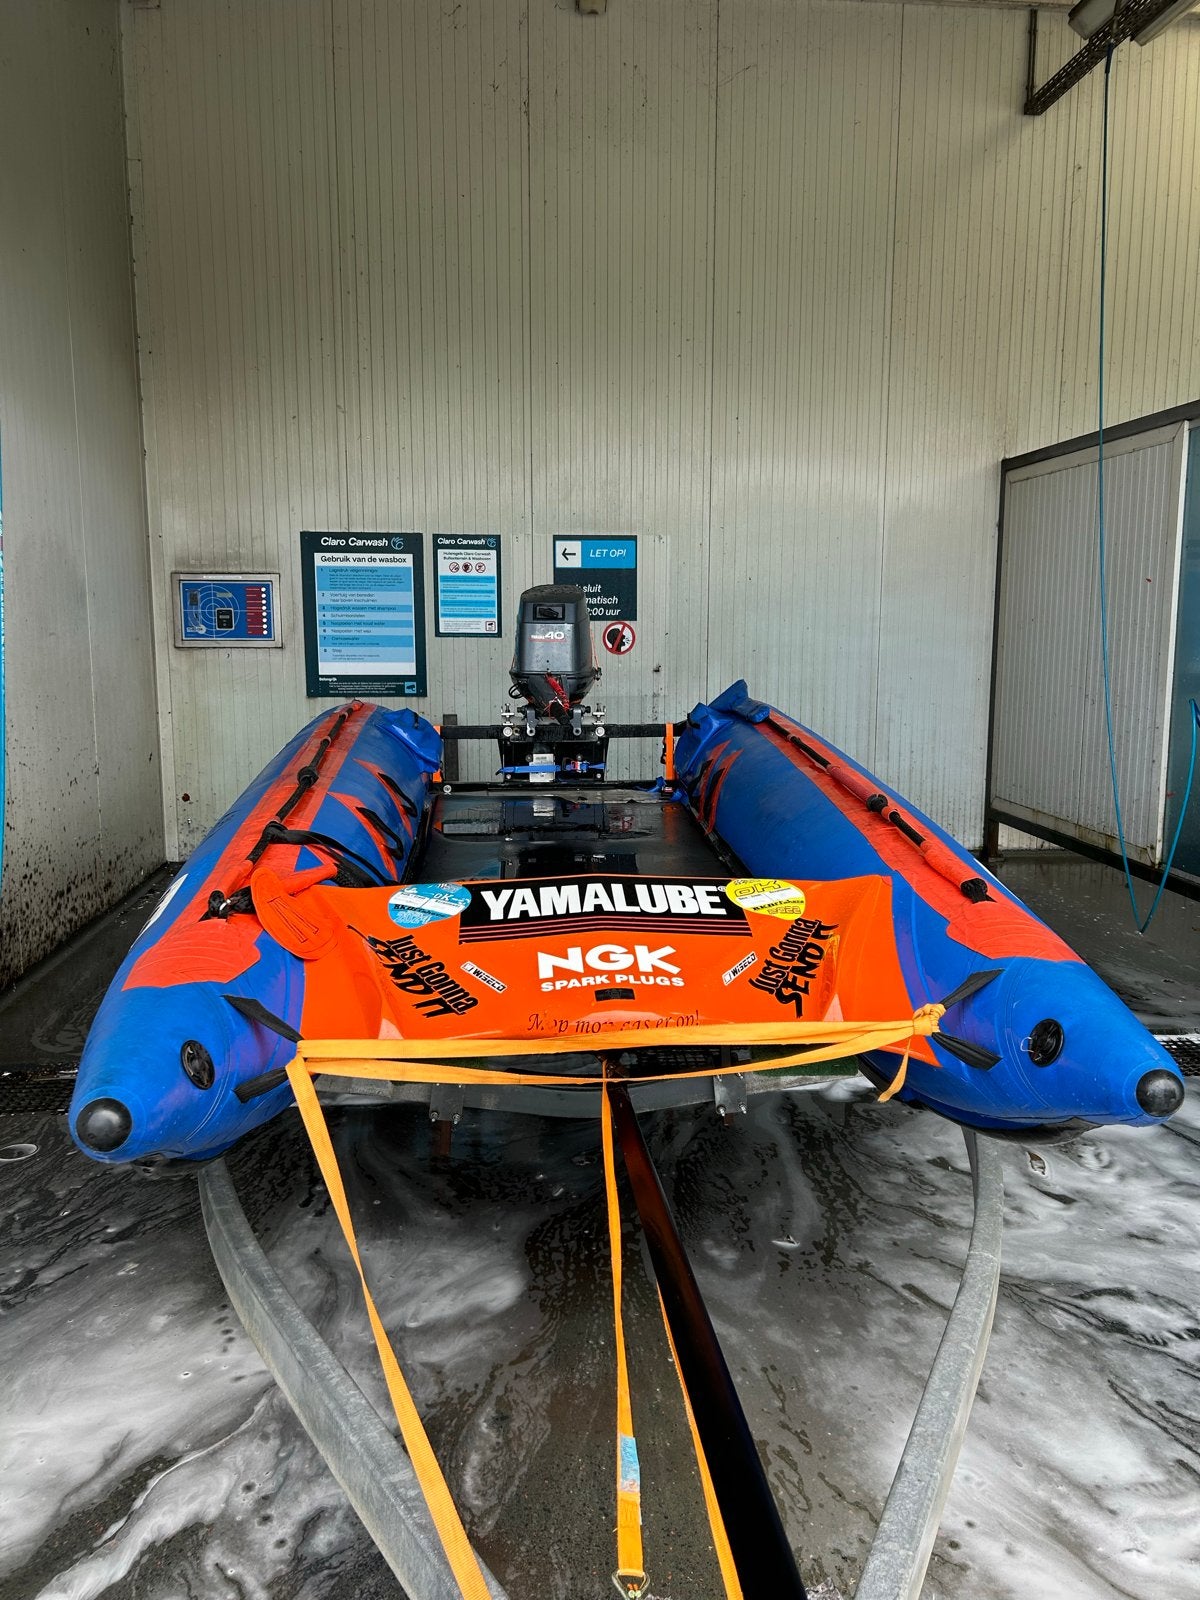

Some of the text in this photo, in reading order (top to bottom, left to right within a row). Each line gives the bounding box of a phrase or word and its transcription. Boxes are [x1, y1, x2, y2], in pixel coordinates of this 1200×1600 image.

[320, 536, 389, 547] Claro Carwash
[320, 555, 351, 563] Gebruik
[589, 549, 626, 558] LET OP!
[582, 584, 602, 592] sluit
[544, 631, 565, 640] 40
[735, 880, 781, 897] OK
[480, 883, 727, 920] YAMALUBE
[537, 944, 681, 980] NGK
[540, 974, 685, 992] SPARK PLUGS
